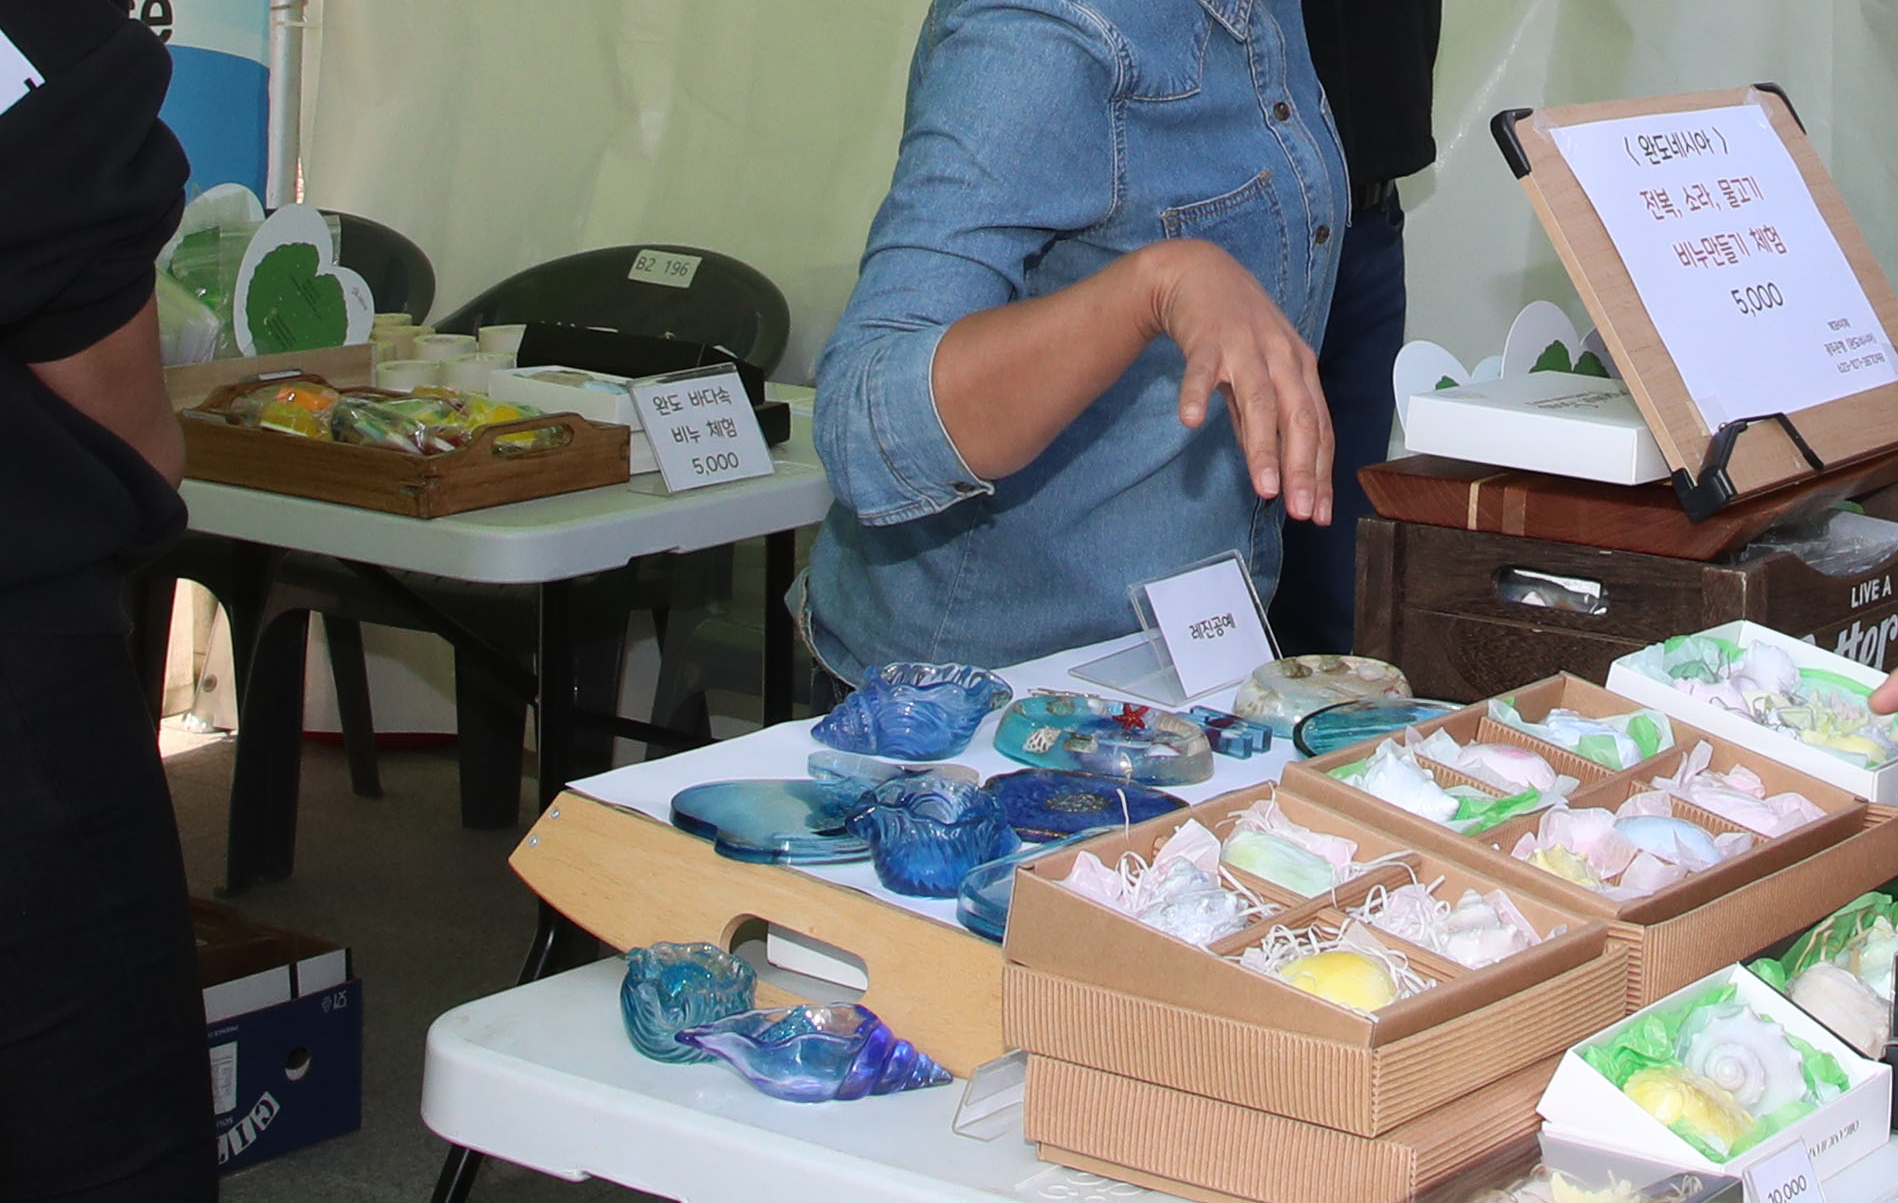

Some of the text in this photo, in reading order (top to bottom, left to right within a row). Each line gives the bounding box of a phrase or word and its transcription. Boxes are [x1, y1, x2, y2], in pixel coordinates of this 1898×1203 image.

[1639, 175, 1765, 221] 전복, 소라, 물고기
[1672, 224, 1788, 269] 비누만들기 체험
[636, 256, 690, 276] B2 196
[1731, 282, 1784, 317] 5,000
[652, 386, 732, 416] 완도 바다속
[671, 417, 738, 444] 비누 체험
[692, 451, 740, 476] 5,000
[1851, 574, 1893, 609] LIVE A
[1188, 612, 1236, 640] 레진공예
[1767, 1174, 1807, 1203] 10,000
